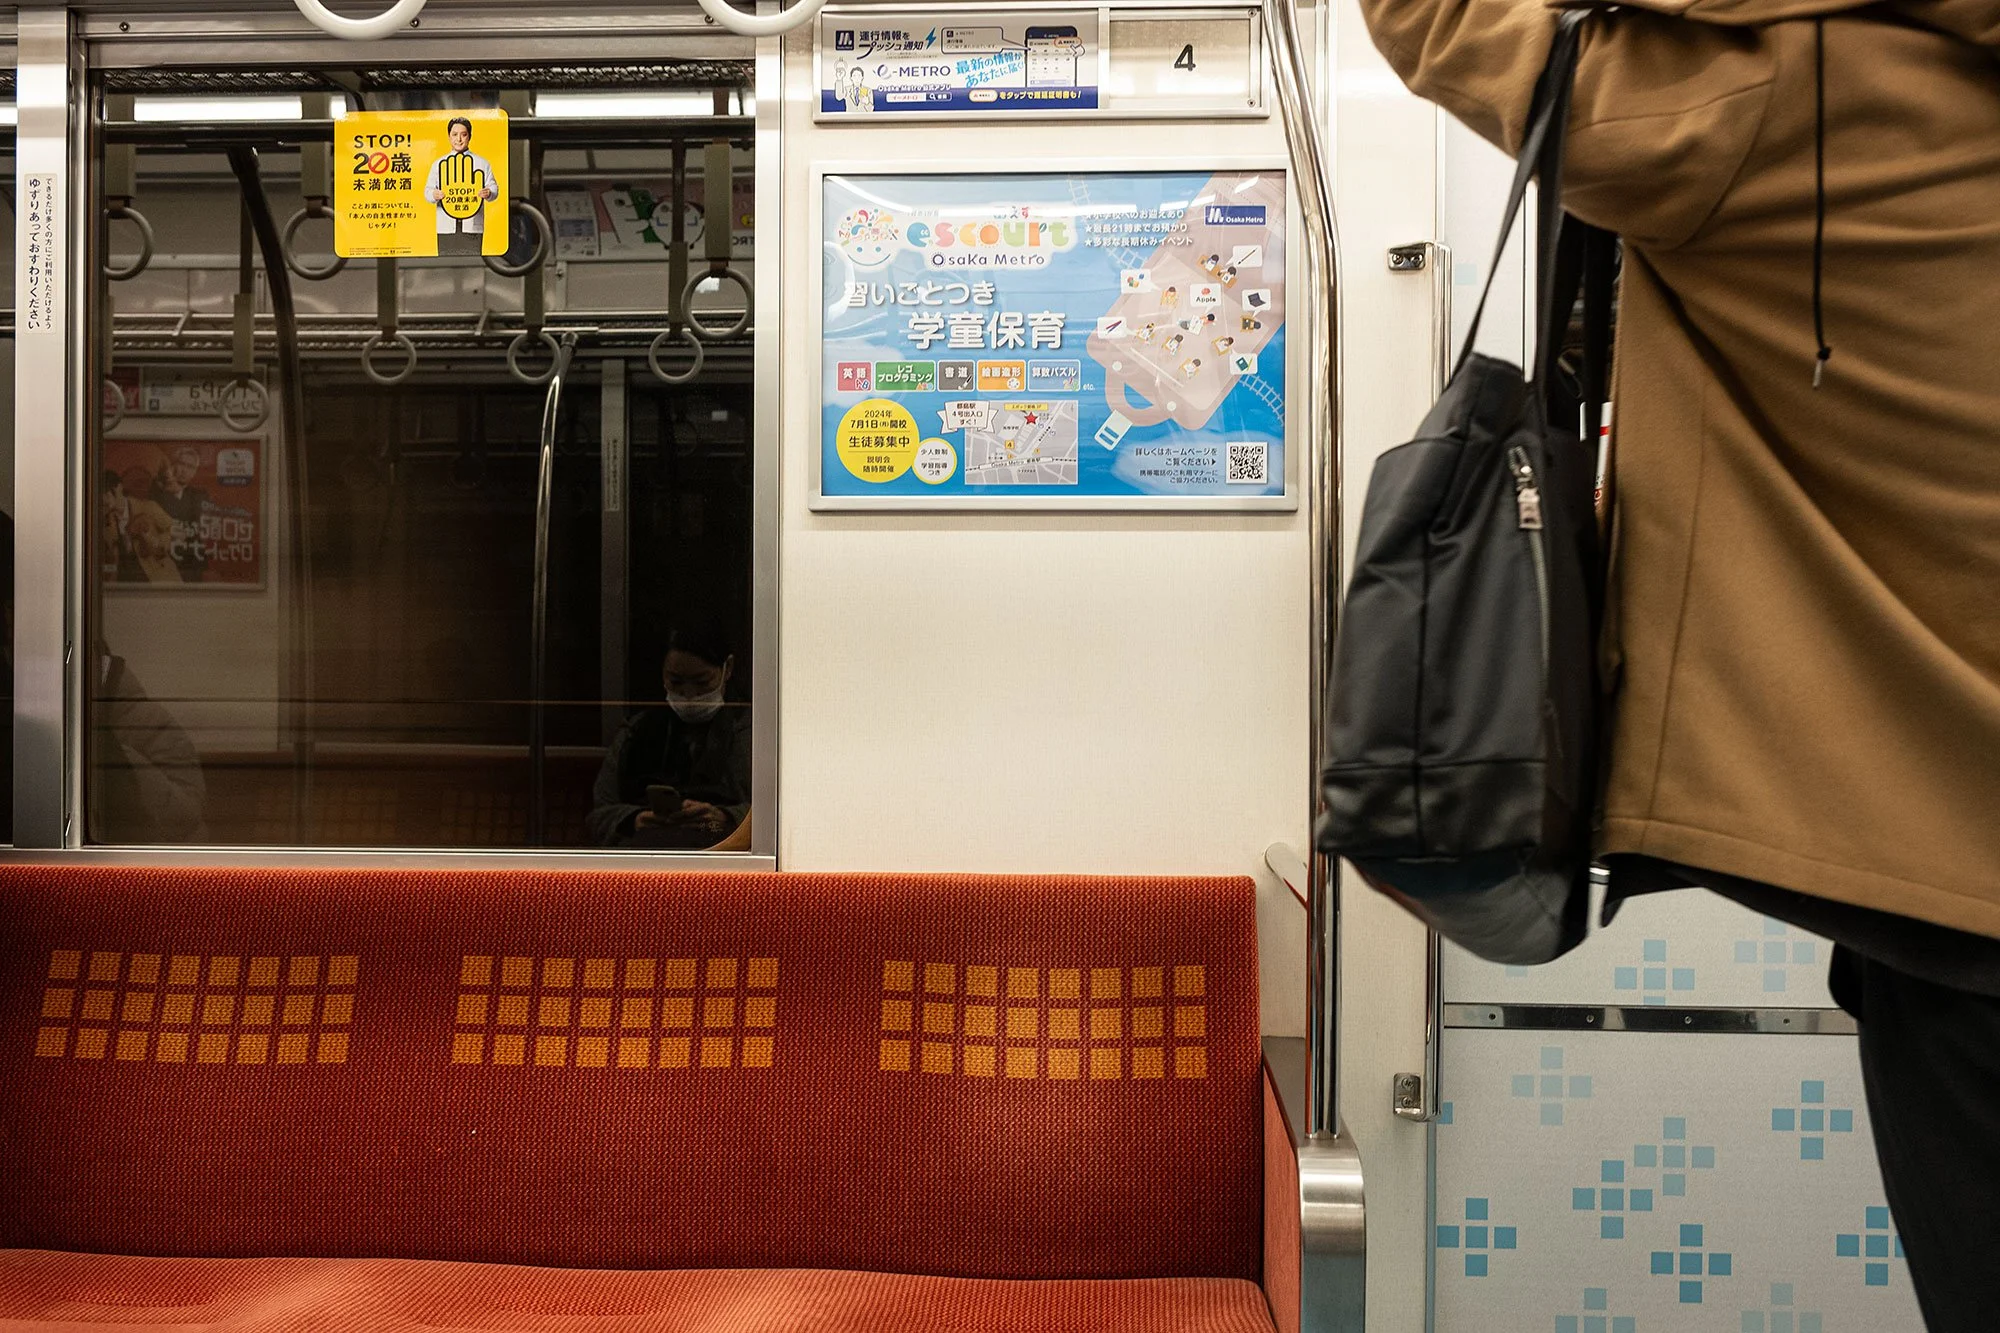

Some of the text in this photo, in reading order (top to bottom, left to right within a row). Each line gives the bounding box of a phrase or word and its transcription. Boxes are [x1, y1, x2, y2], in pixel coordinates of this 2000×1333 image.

[860, 31, 910, 42] 運行情報を
[857, 41, 925, 60] プッシュ通知
[955, 52, 1023, 75] 最新の情報が
[1174, 44, 1196, 71] 4
[353, 134, 412, 149] STOP!
[353, 177, 412, 191] 未満飲酒
[454, 204, 470, 212] 飲酒
[1225, 215, 1265, 224] Osaka Metro
[906, 221, 1070, 248] escourt
[28, 178, 41, 330] ゆずりあっておすわりください
[994, 253, 1045, 266] Metro
[847, 279, 997, 307] 習いごとつき
[1196, 296, 1216, 304] Apple
[906, 310, 1066, 350] 学童保育
[843, 367, 867, 379] 英語
[897, 364, 914, 374] レゴ
[944, 366, 968, 378] 書道
[1031, 366, 1076, 378] 算数パズル
[878, 372, 934, 383] プログラミング
[864, 410, 893, 418] 2024年
[849, 435, 910, 449] 生徒募集中
[920, 448, 949, 456] 少人数制
[1136, 448, 1218, 456] 詳しくはホームページを
[867, 456, 891, 464] 説明会
[863, 465, 894, 473] 随時開催
[1139, 469, 1218, 477] 携帯電話のご利用マナーに
[1170, 476, 1218, 484] ご協力ください。
